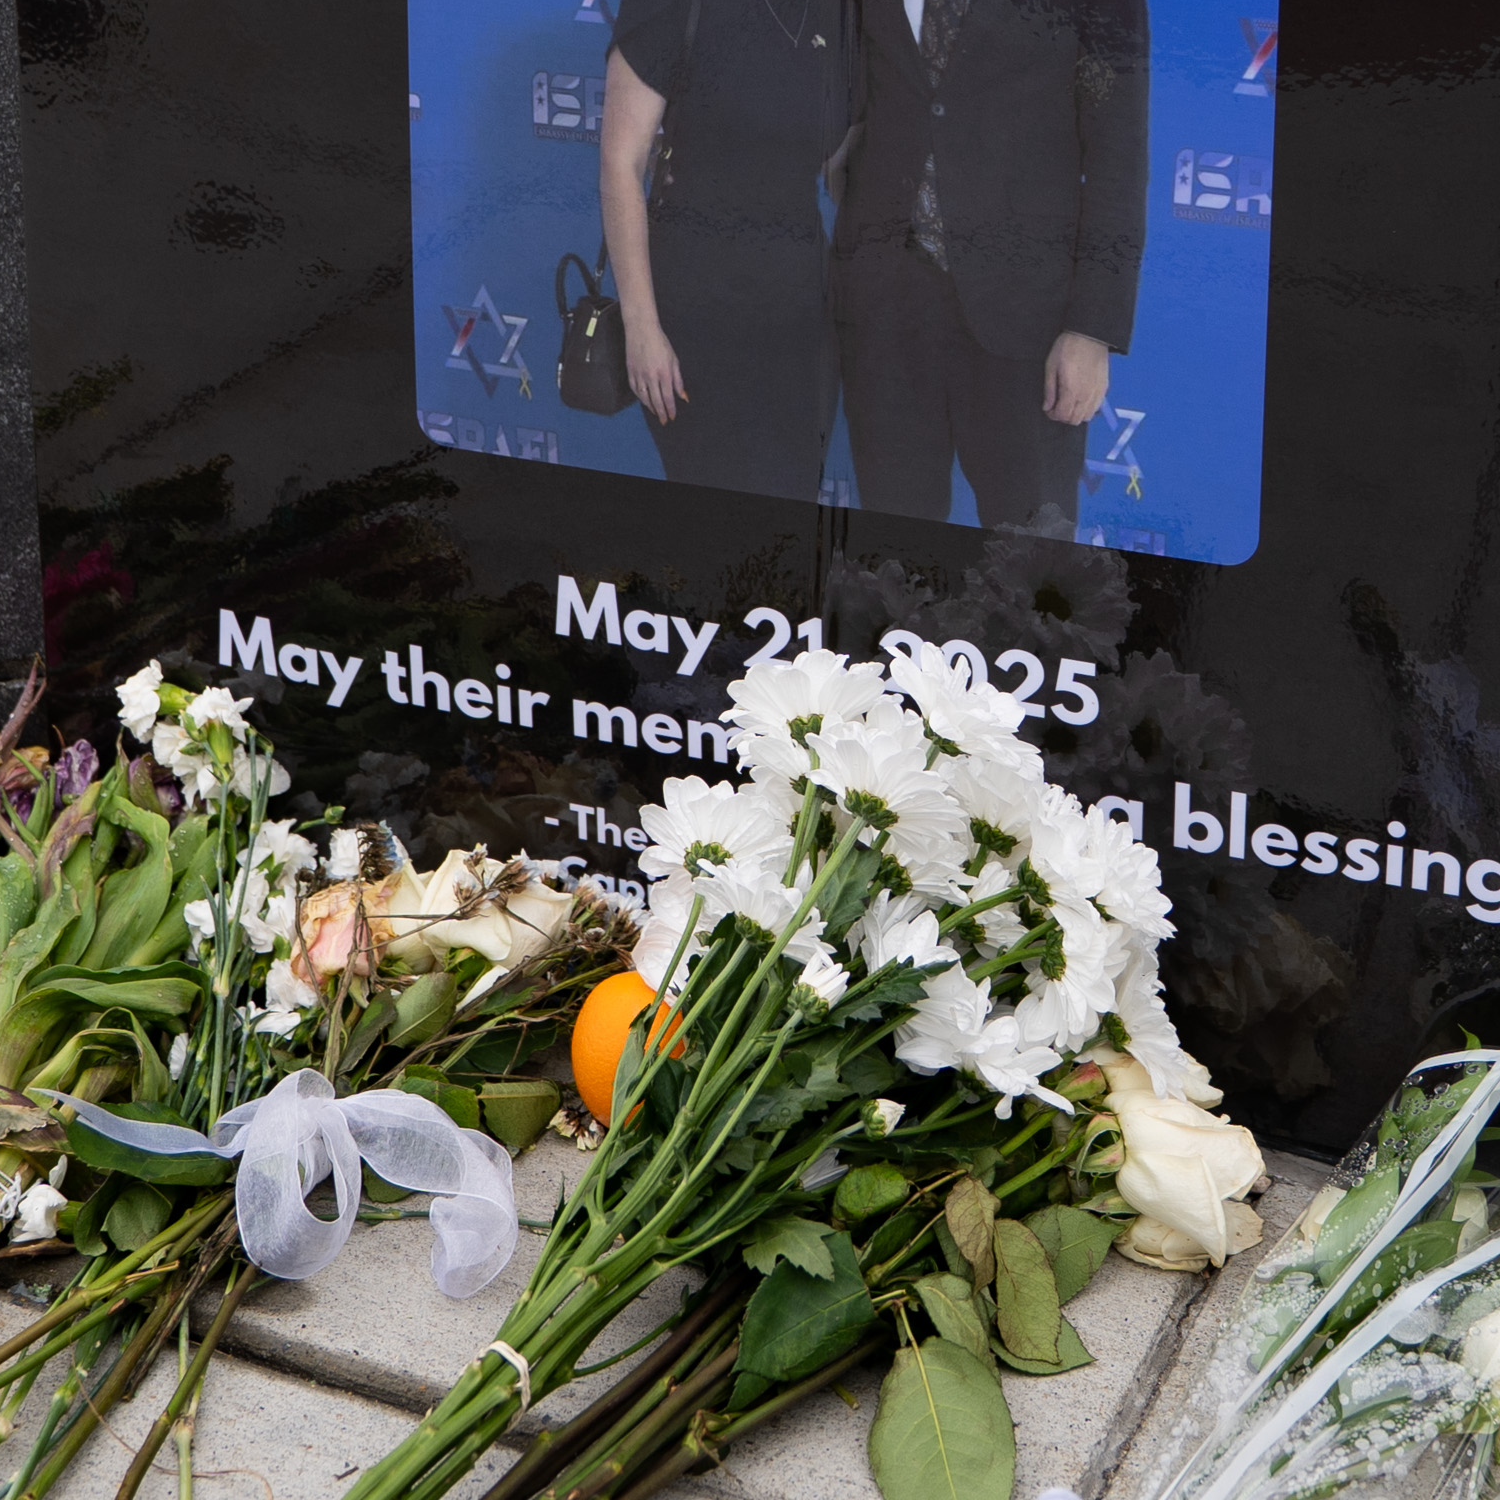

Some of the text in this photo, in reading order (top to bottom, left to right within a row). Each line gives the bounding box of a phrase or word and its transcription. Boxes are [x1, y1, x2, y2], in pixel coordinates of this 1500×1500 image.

[218, 607, 364, 708] May
[381, 643, 550, 729] their
[572, 698, 739, 764] mem
[554, 574, 721, 677] May
[879, 628, 1100, 726] 2025
